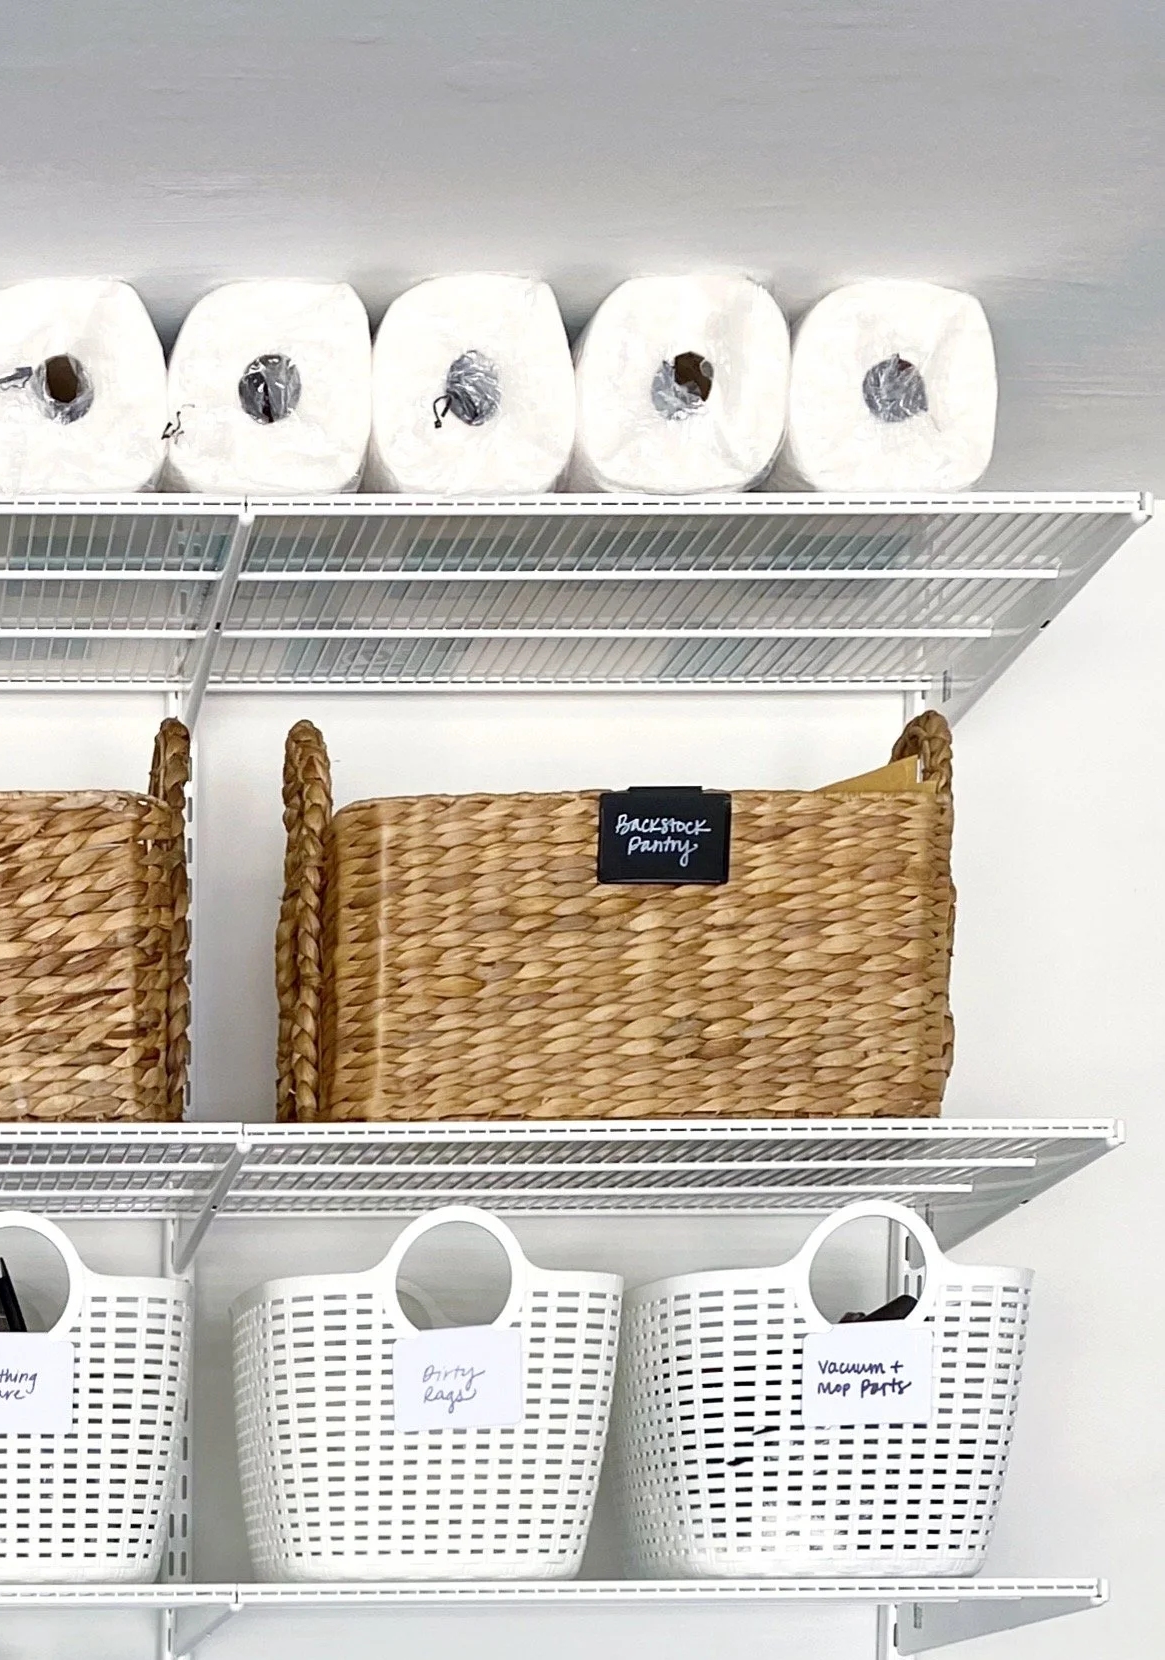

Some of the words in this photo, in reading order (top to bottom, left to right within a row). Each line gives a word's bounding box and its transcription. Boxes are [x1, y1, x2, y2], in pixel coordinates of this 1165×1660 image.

[615, 813, 712, 836] Backstock
[422, 1364, 486, 1391] Dirty
[817, 1360, 886, 1374] Vacuum
[890, 1360, 904, 1374] +
[423, 1385, 477, 1414] Rags
[817, 1381, 851, 1397] Mop
[861, 1377, 912, 1399] Parts
